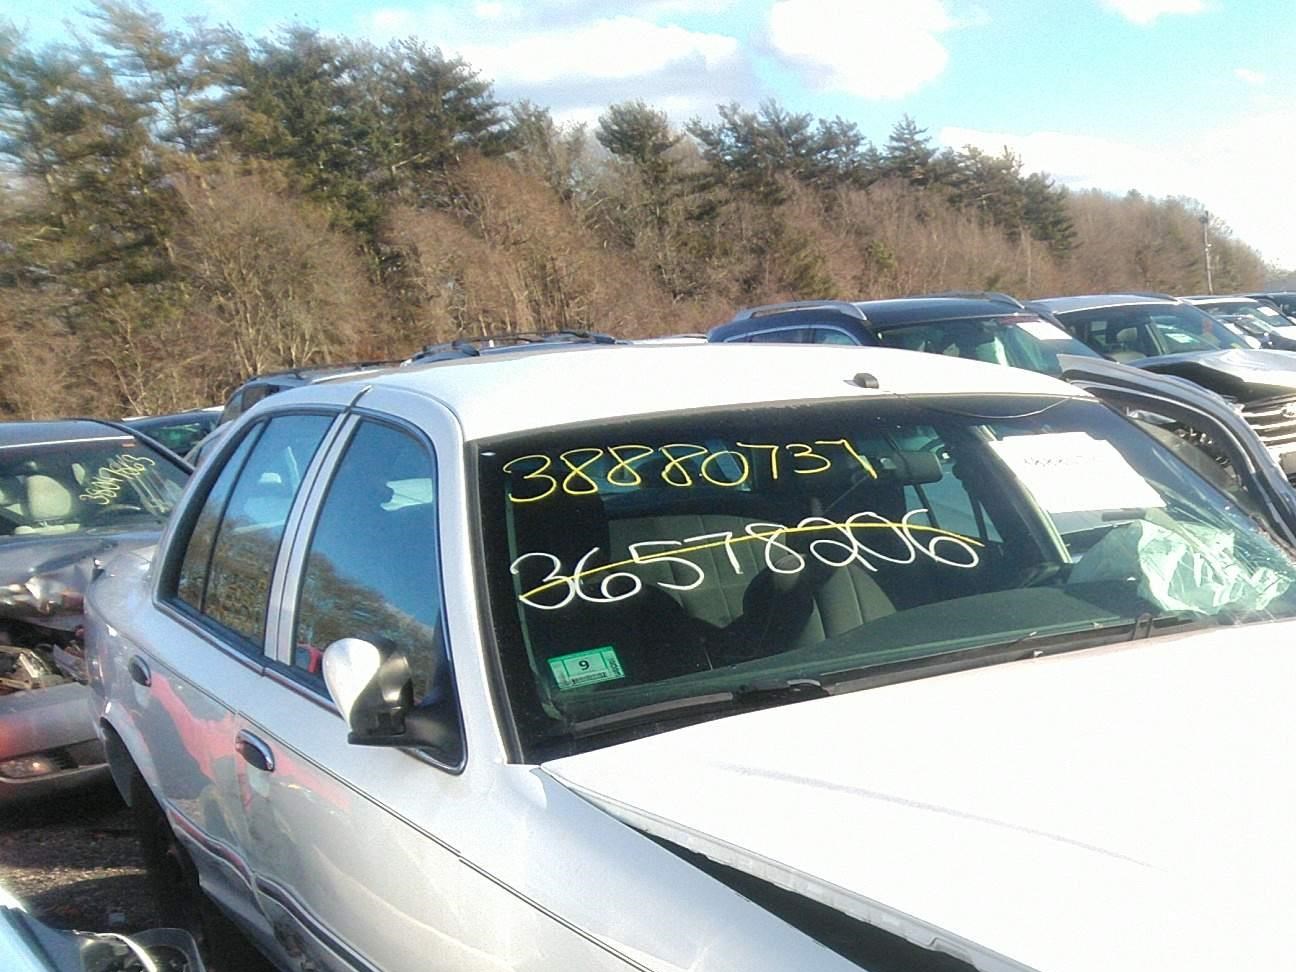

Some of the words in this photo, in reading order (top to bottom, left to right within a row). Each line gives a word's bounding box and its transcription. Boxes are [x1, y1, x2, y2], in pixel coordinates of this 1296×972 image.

[502, 439, 879, 503] 38880737
[510, 508, 981, 610] 36578206
[578, 660, 590, 671] 9
